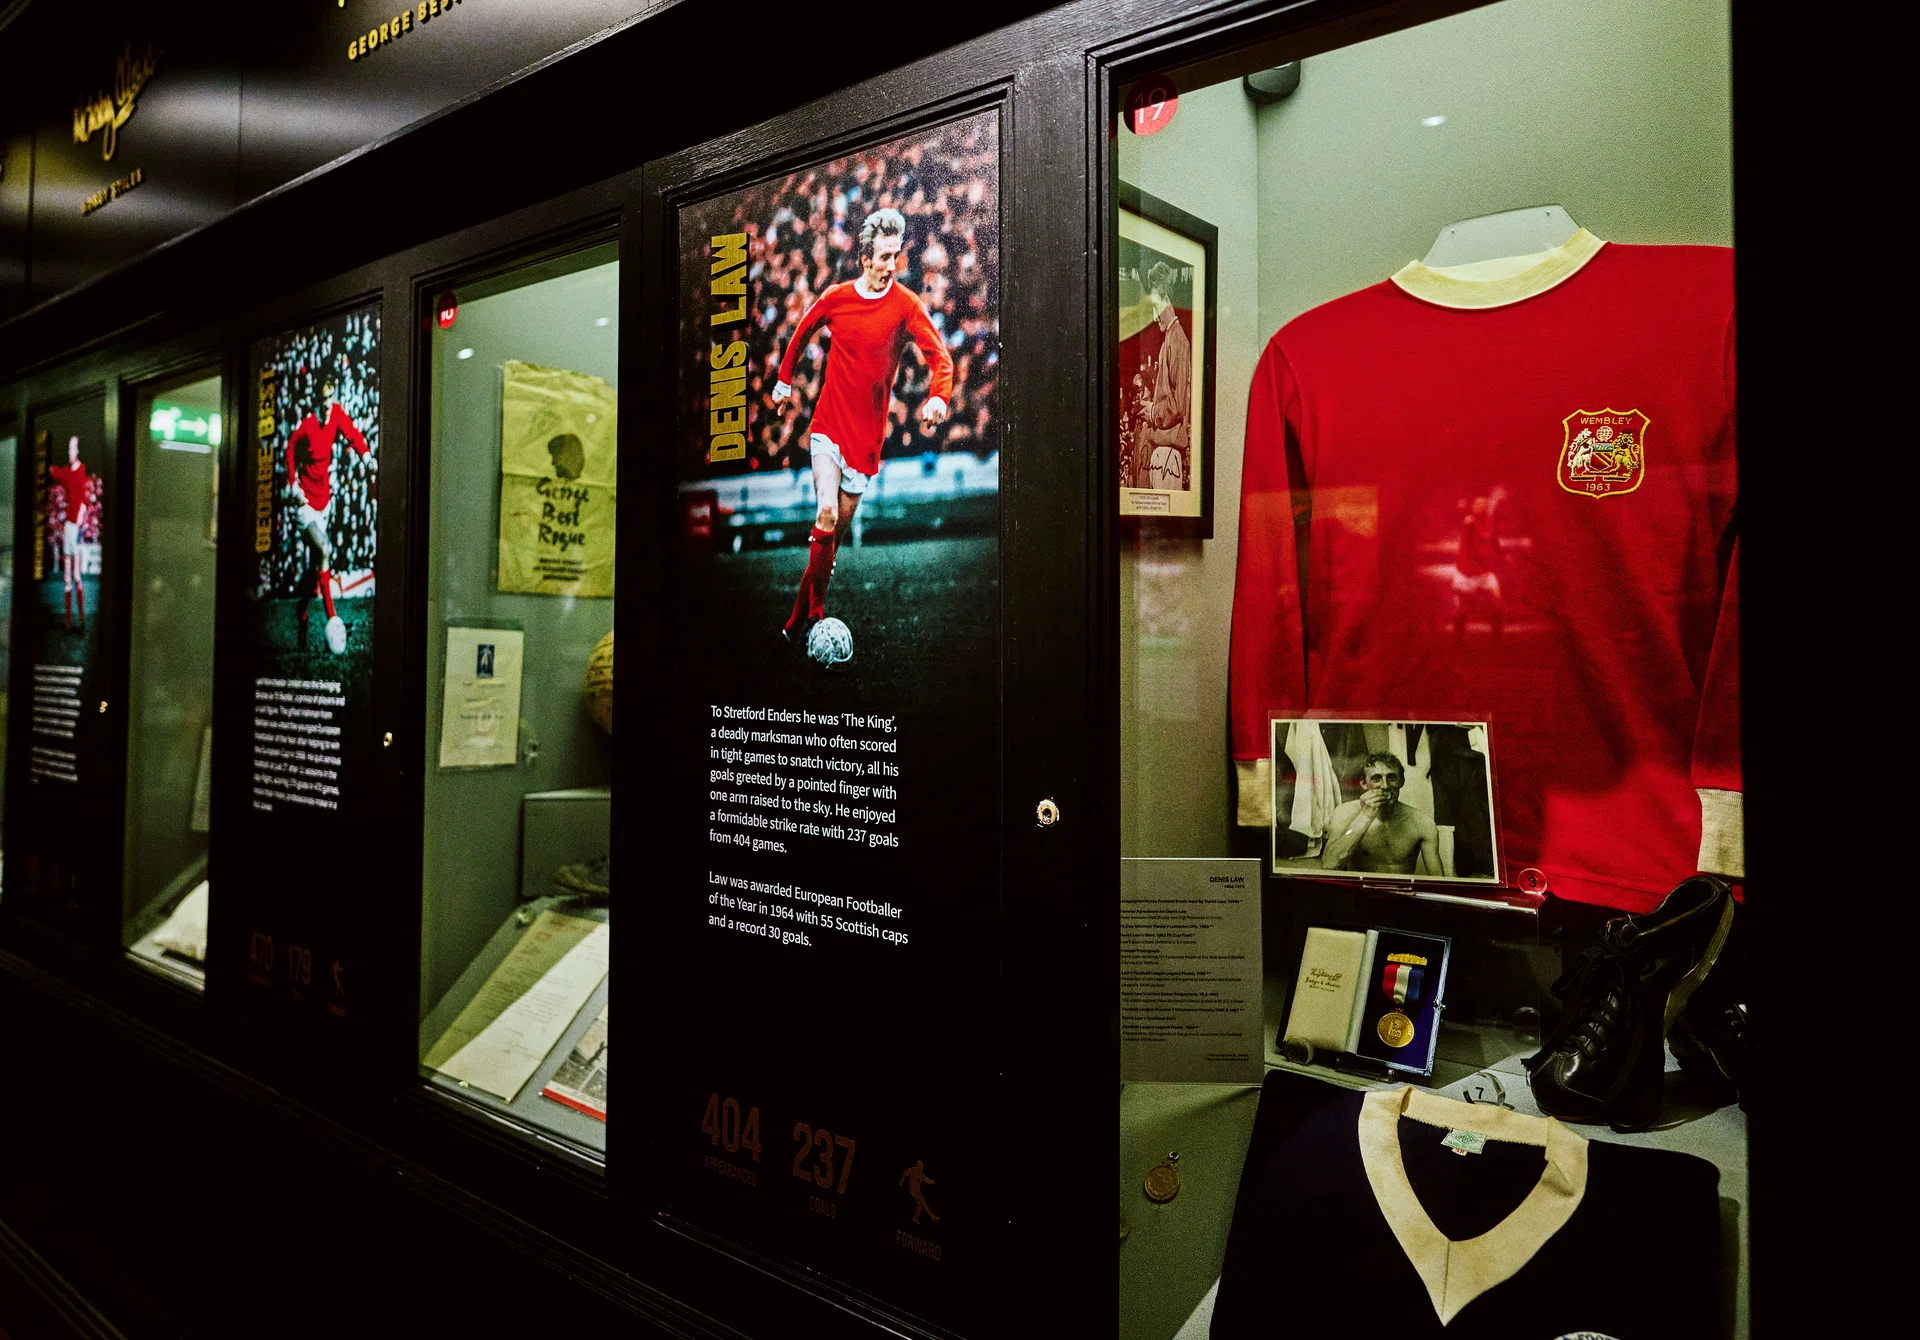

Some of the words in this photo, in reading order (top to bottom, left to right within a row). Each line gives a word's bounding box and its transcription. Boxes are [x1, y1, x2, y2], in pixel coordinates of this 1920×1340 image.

[347, 10, 411, 60] GEORGE
[710, 232, 747, 326] LAW
[258, 368, 276, 438] BEST
[710, 341, 747, 462] DENIS
[1580, 416, 1633, 425] WEMBLEY
[256, 446, 275, 553] GEORGE
[1585, 483, 1611, 491] 1963
[543, 501, 580, 526] Best
[538, 523, 586, 552] Rogue
[711, 705, 722, 717] To
[724, 706, 765, 720] Stretford
[768, 709, 801, 723] Enders
[804, 710, 816, 724] he
[818, 715, 839, 725] was
[841, 713, 864, 727] ‘The
[868, 715, 897, 732] King’,
[711, 729, 716, 737] a
[718, 726, 749, 743] deadly
[752, 730, 802, 745] marksman
[805, 733, 827, 747] who
[830, 735, 857, 749] often
[860, 739, 896, 752] scored
[711, 746, 719, 758] in
[721, 748, 742, 763] tight
[744, 753, 775, 765] games
[778, 753, 788, 765] to
[790, 756, 823, 769] snatch
[826, 757, 864, 776] victory,
[867, 761, 880, 775] all
[883, 762, 899, 776] his
[710, 768, 734, 782] goals
[736, 773, 772, 785] greeted
[775, 774, 786, 790] by
[789, 779, 794, 788] a
[798, 778, 836, 792] pointed
[839, 780, 870, 799] finger
[872, 785, 896, 800] with
[710, 791, 727, 801] one
[729, 793, 747, 804] arm
[751, 794, 779, 808] raised
[781, 797, 791, 809] to
[794, 798, 810, 812] the
[813, 800, 832, 817] sky.
[836, 804, 850, 817] He
[852, 807, 895, 824] enjoyed
[710, 812, 715, 820] a
[718, 809, 768, 828] formidable
[770, 818, 797, 832] strike
[800, 823, 819, 835] rate
[822, 825, 844, 839] with
[847, 828, 866, 842] 237
[869, 833, 898, 847] goals
[710, 829, 731, 843] from
[733, 834, 750, 847] 404
[753, 839, 787, 853] games.
[710, 871, 728, 885] Law
[730, 878, 748, 889] was
[750, 882, 792, 897] awarded
[795, 887, 843, 907] European
[847, 896, 902, 918] Footballer
[1528, 876, 1537, 888] 3
[709, 892, 718, 904] of
[720, 894, 735, 908] the
[737, 897, 757, 912] Year
[759, 901, 767, 914] in
[770, 905, 794, 920] 1964
[796, 911, 818, 925] with
[821, 915, 833, 928] 55
[836, 918, 879, 938] Scottish
[882, 930, 908, 945] caps
[709, 915, 725, 927] and
[728, 920, 733, 929] a
[736, 922, 766, 936] record
[768, 926, 780, 939] 30
[783, 932, 811, 946] goals.
[1475, 1086, 1484, 1099] 7
[701, 1092, 762, 1163] 404
[792, 1121, 856, 1195] 237
[703, 1153, 758, 1187] APPEARANCES
[807, 1195, 837, 1219] GOALS
[895, 1228, 942, 1262] FORWARD
